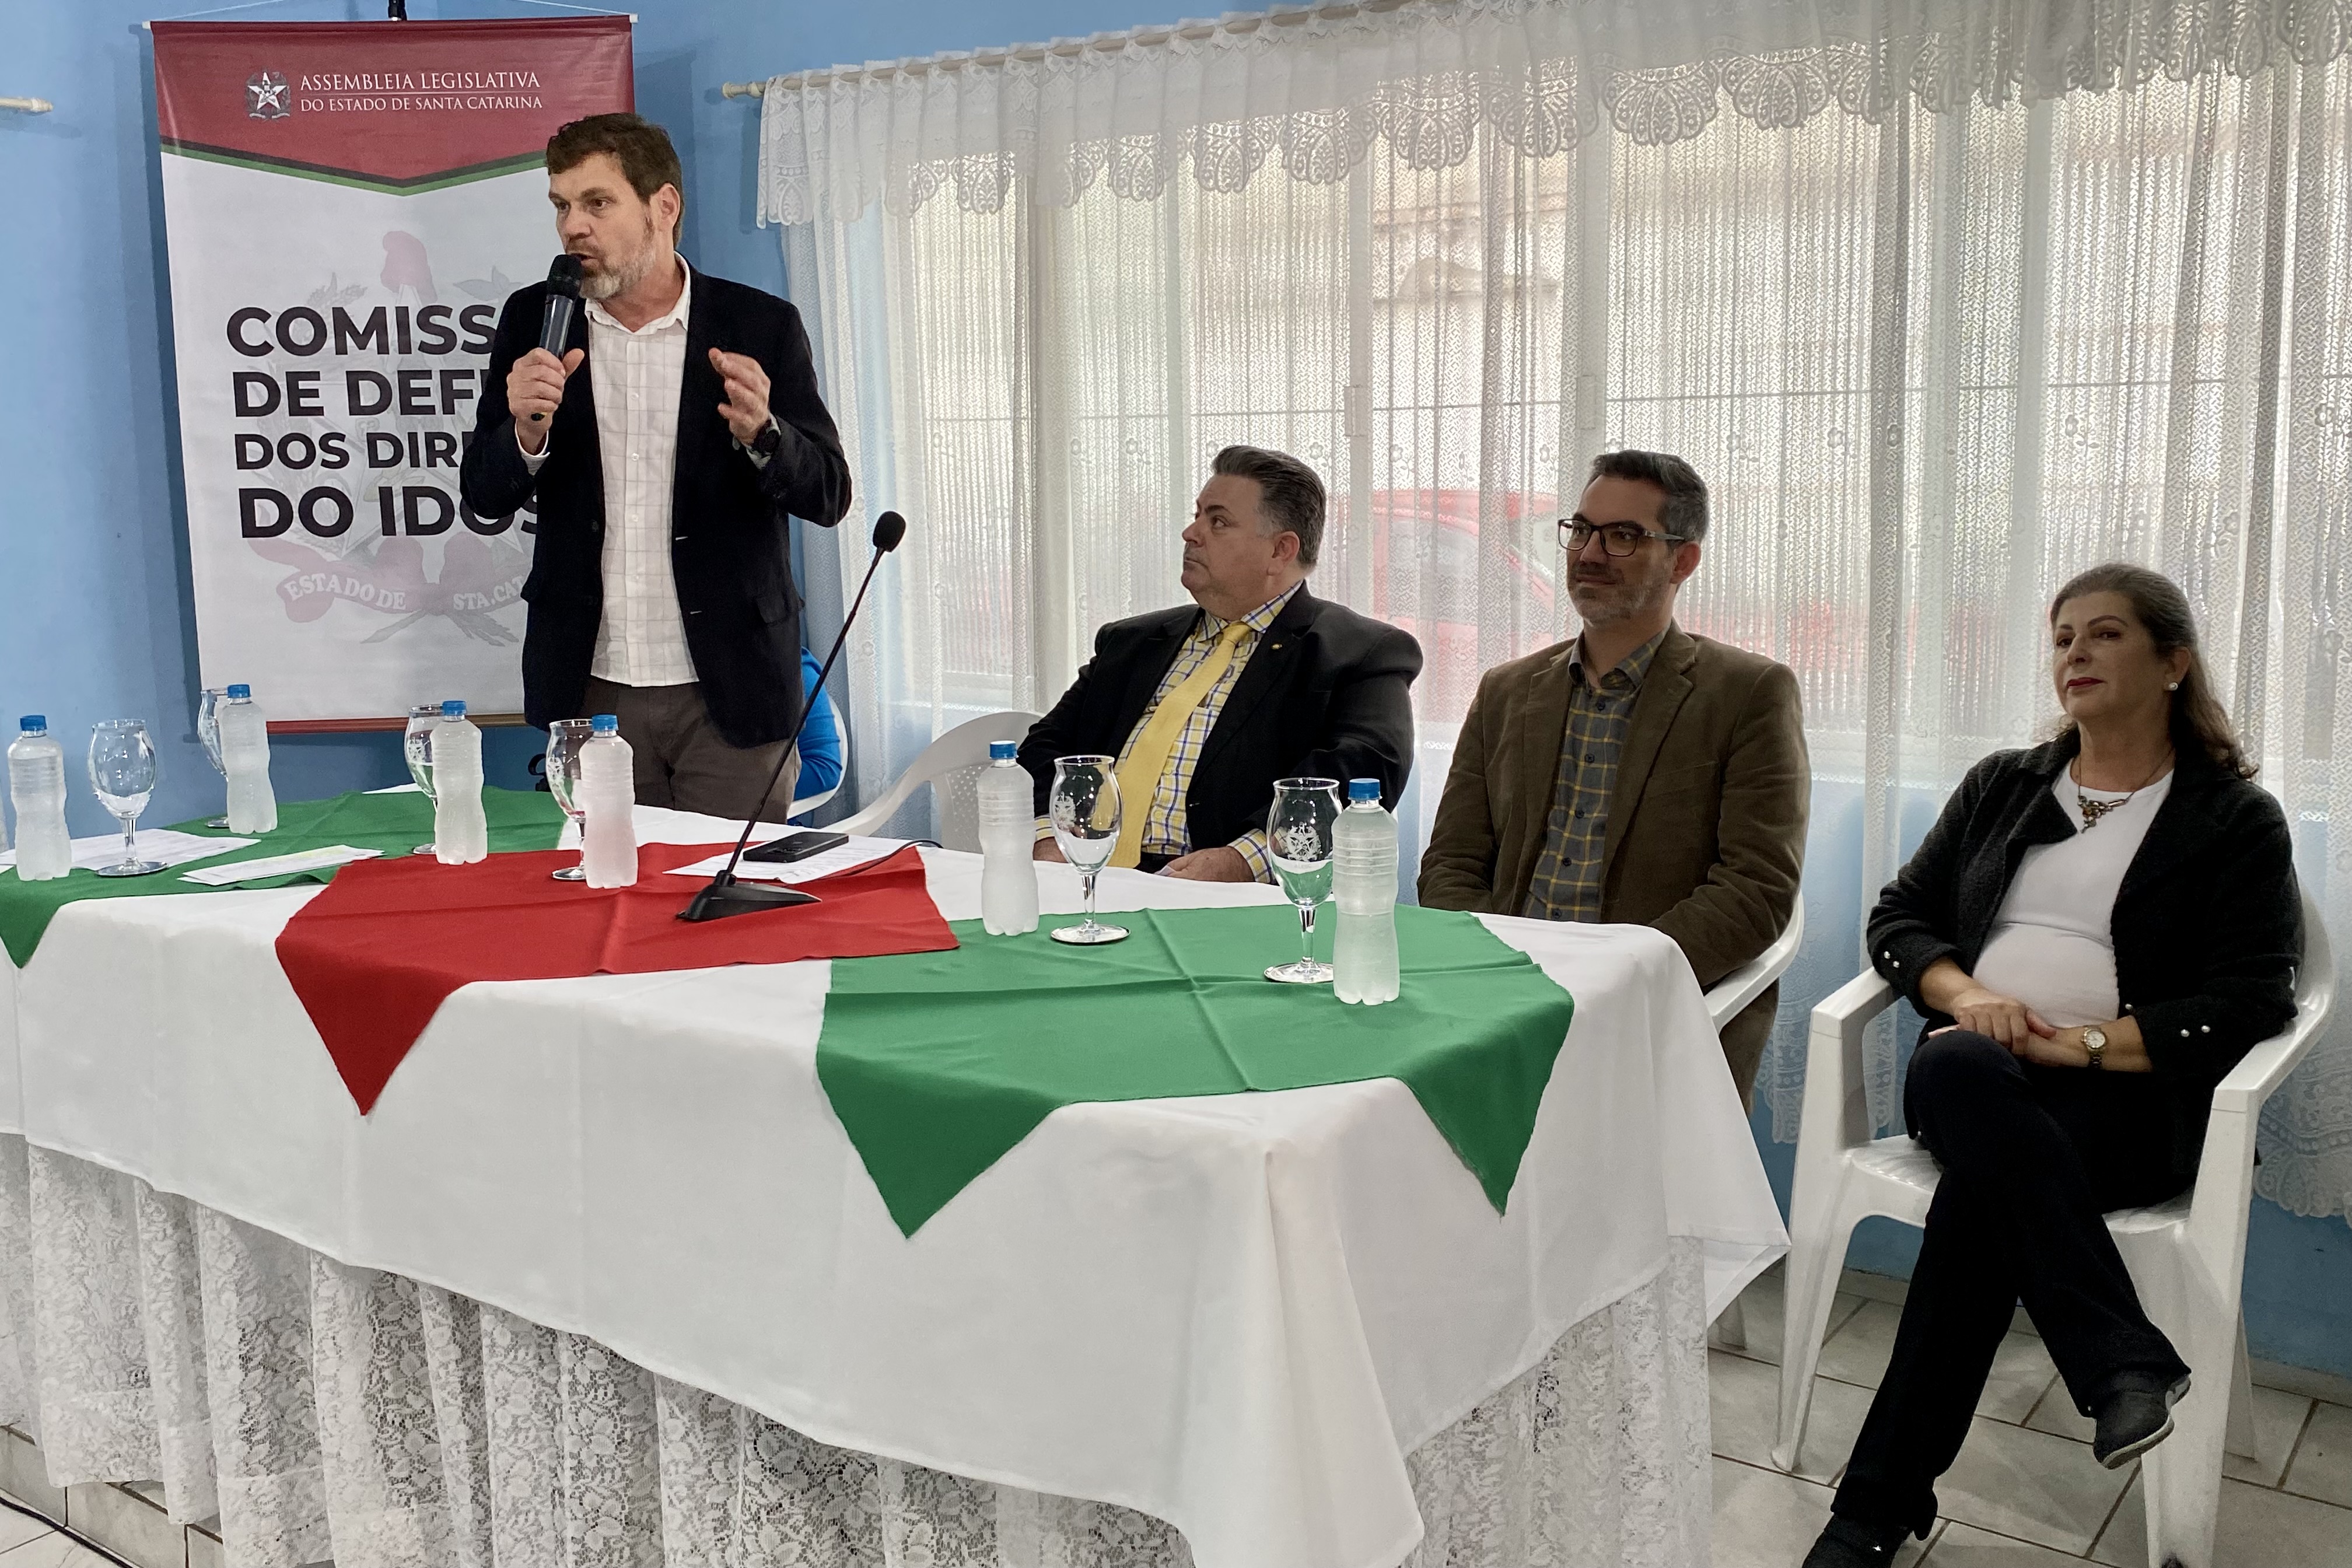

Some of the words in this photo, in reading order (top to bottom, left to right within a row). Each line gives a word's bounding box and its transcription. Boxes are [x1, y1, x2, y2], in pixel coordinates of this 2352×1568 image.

[300, 73, 415, 91] ASSEMBLEIA
[421, 71, 540, 89] LEGISLATIVA
[301, 99, 324, 111] DO
[330, 97, 386, 111] ESTADO
[392, 97, 411, 111] DE
[415, 97, 463, 110] SANTA
[467, 96, 542, 109] CATARINA
[226, 304, 497, 357] COMISS
[232, 370, 324, 417] DE
[345, 369, 490, 416] DEF
[235, 432, 350, 470] DOS
[366, 431, 474, 468] DIR
[239, 486, 354, 538] DO
[284, 573, 375, 601] ESTADO
[375, 589, 407, 611] DE
